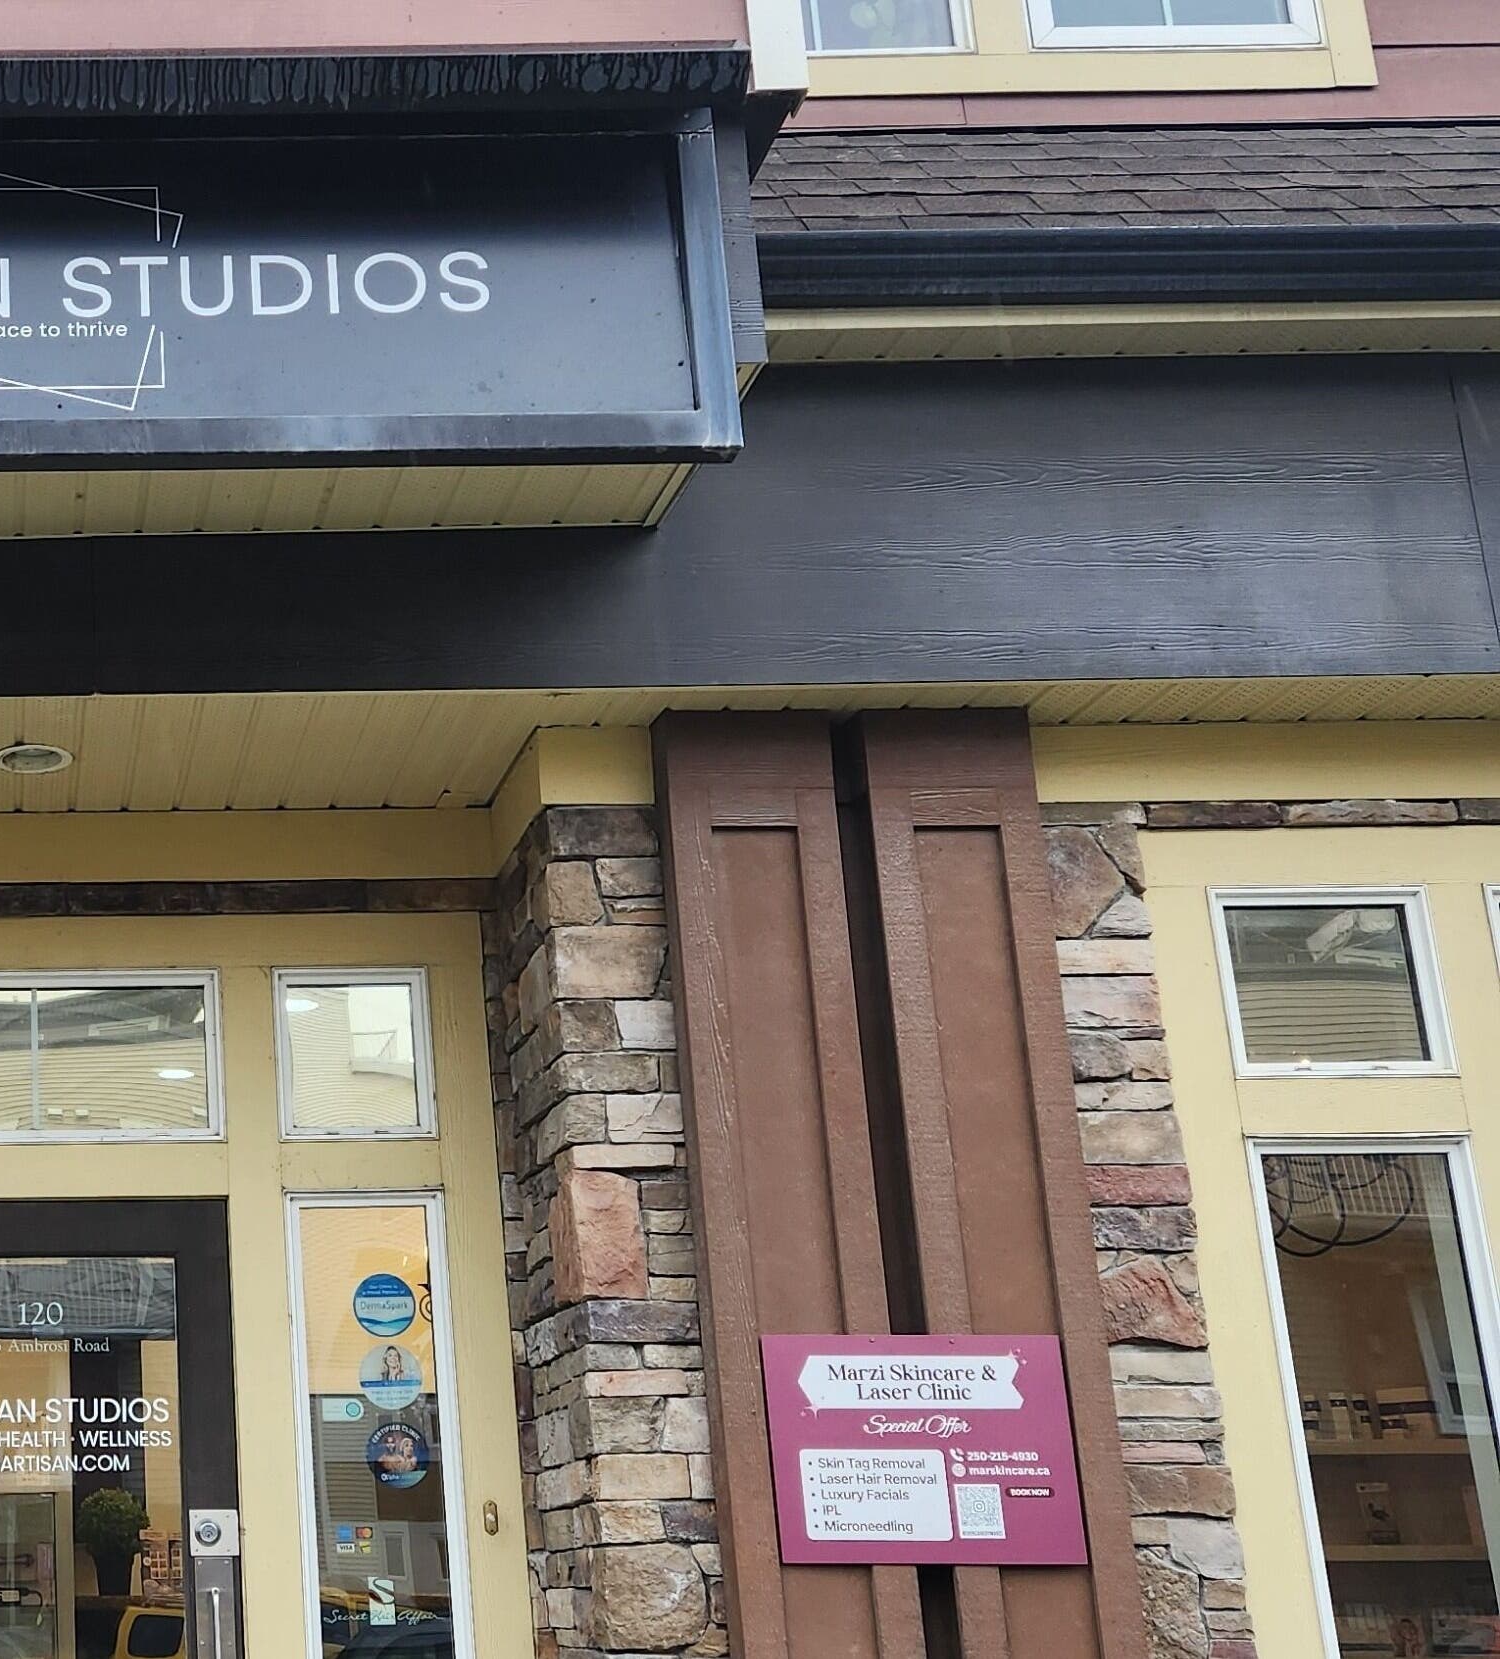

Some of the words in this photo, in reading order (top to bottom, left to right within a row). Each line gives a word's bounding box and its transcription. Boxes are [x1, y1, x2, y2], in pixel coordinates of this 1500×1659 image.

[62, 251, 491, 318] STUDIOS
[39, 322, 61, 338] to
[67, 320, 128, 337] thrive
[18, 1301, 64, 1326] 120
[8, 1338, 69, 1353] Ambrosi
[74, 1337, 110, 1353] Road
[827, 1364, 886, 1381] Marzi
[889, 1363, 976, 1381] Skincare
[981, 1364, 997, 1381] &
[857, 1383, 912, 1400] Laser
[917, 1383, 972, 1400] Clinic
[45, 1398, 170, 1423] STUDIOS
[401, 1425, 421, 1441] CLINIC
[863, 1414, 924, 1437] Special
[925, 1414, 972, 1438] Offer
[79, 1430, 172, 1447] WELLNESS
[818, 1458, 845, 1469] Skin
[848, 1458, 870, 1471] Tag
[872, 1458, 926, 1469] Removal
[819, 1473, 854, 1485] Laser
[856, 1473, 882, 1485] Hair
[884, 1473, 938, 1485] Removal
[821, 1489, 864, 1503] Luxury
[867, 1489, 910, 1500] Facials
[822, 1505, 842, 1516] IPL
[824, 1520, 913, 1534] Microneedling
[323, 1609, 368, 1624] Secret
[397, 1609, 446, 1626] Affair
